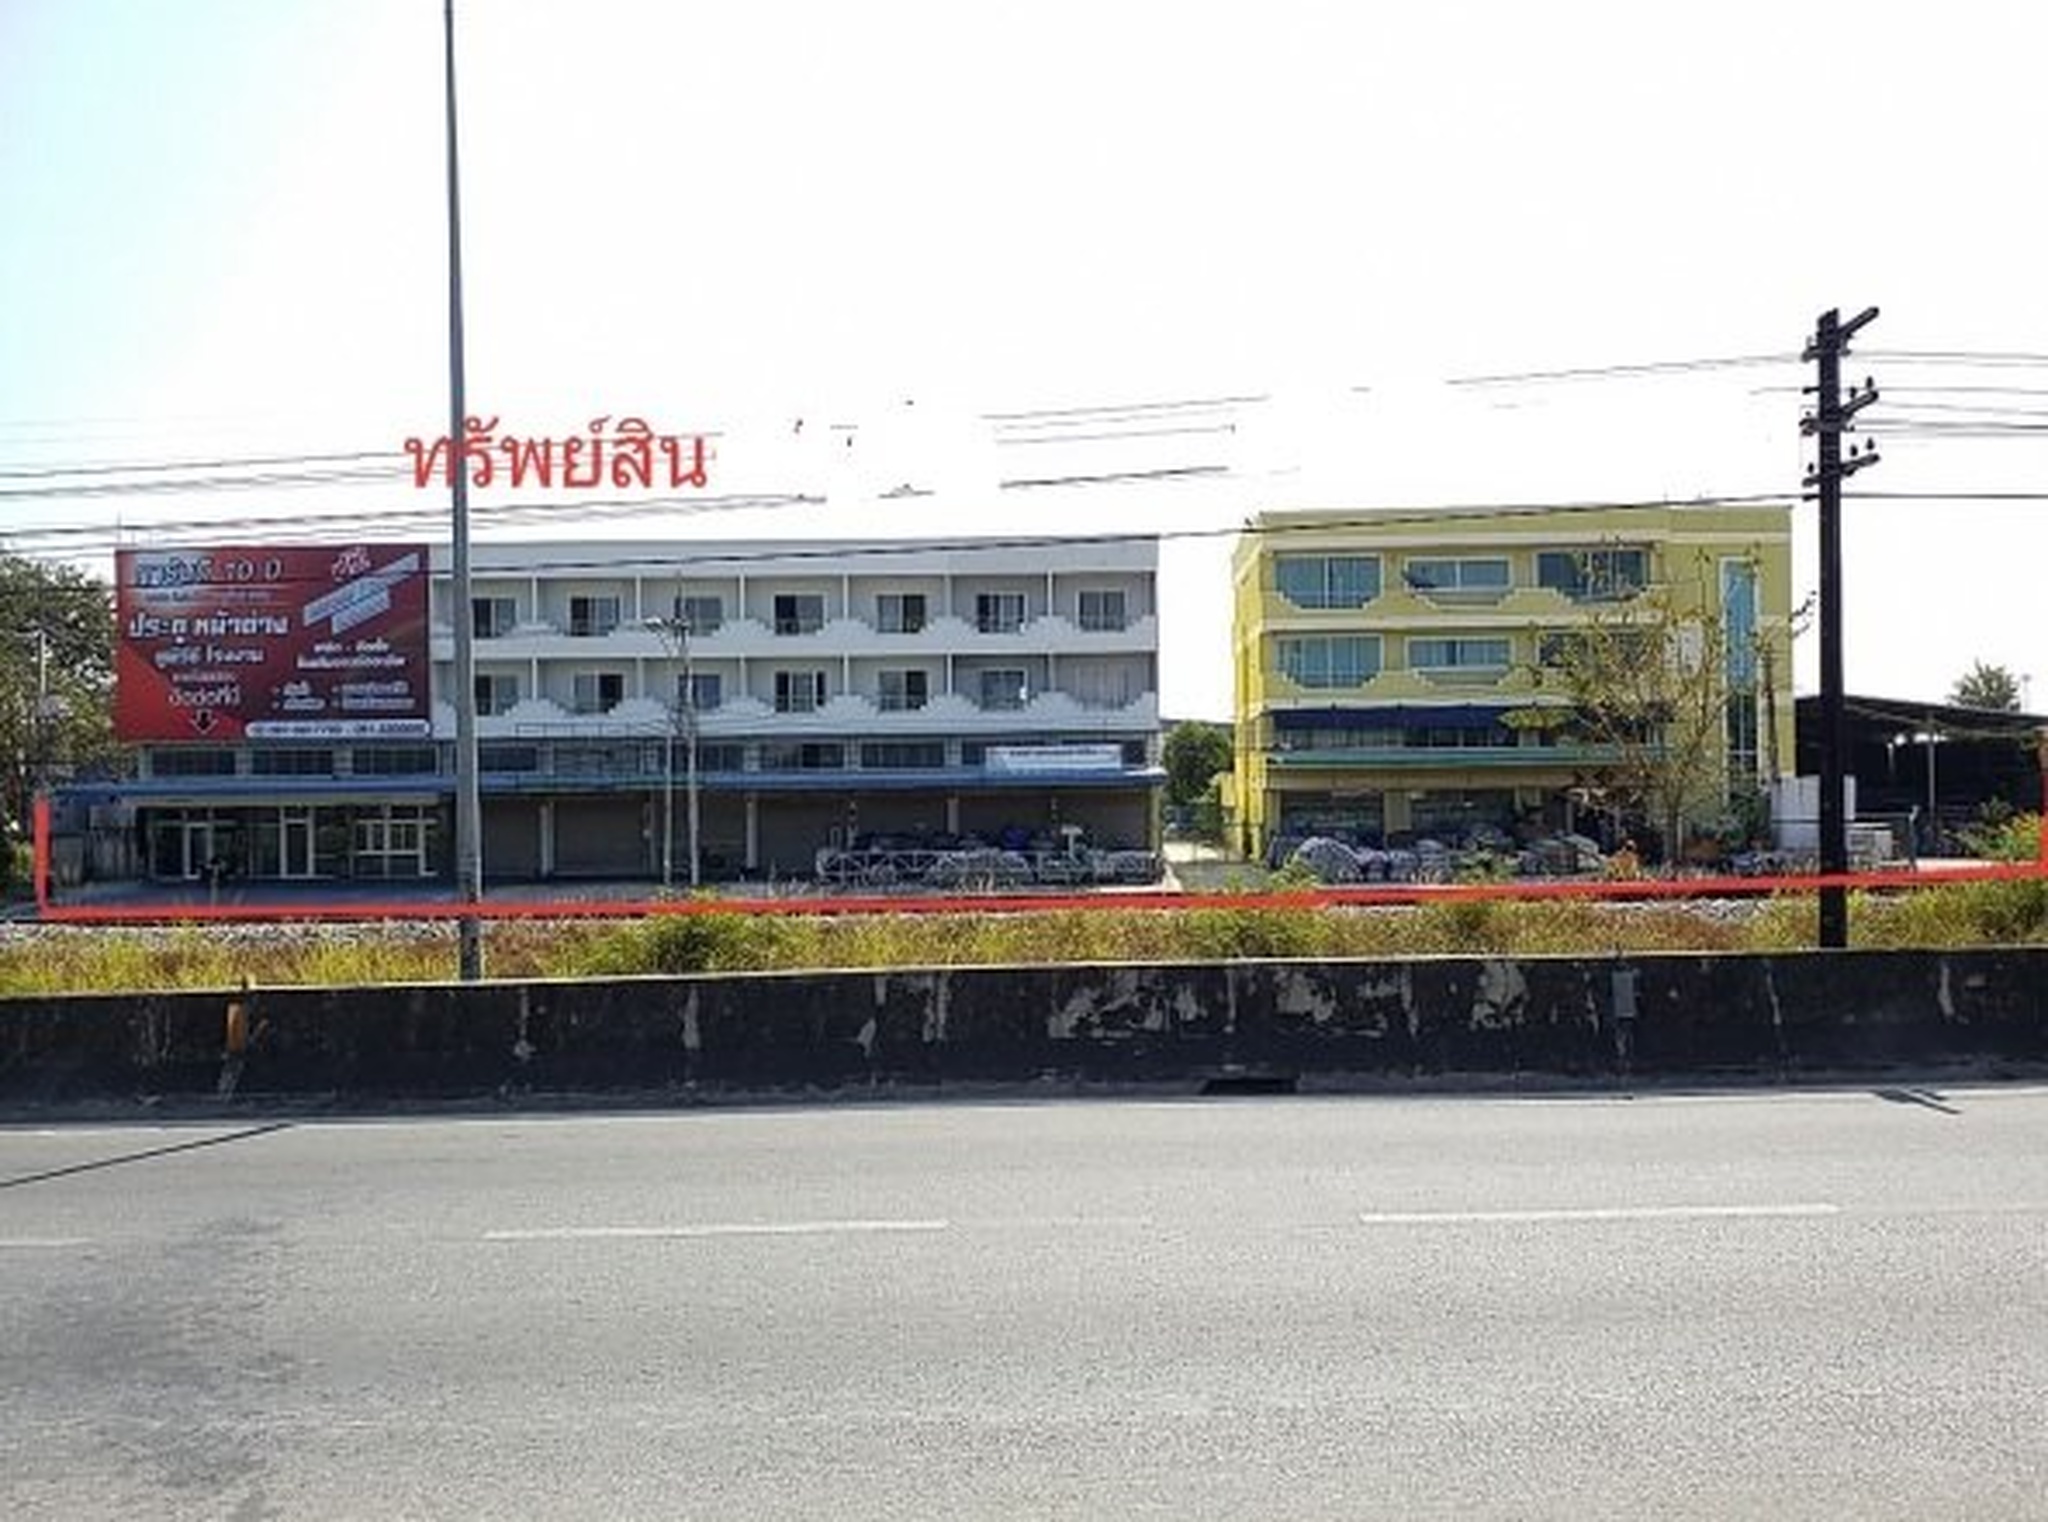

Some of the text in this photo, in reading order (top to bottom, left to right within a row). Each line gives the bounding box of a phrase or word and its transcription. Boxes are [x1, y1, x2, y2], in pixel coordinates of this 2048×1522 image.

[129, 609, 289, 645] ประตู หน้าต่าง
